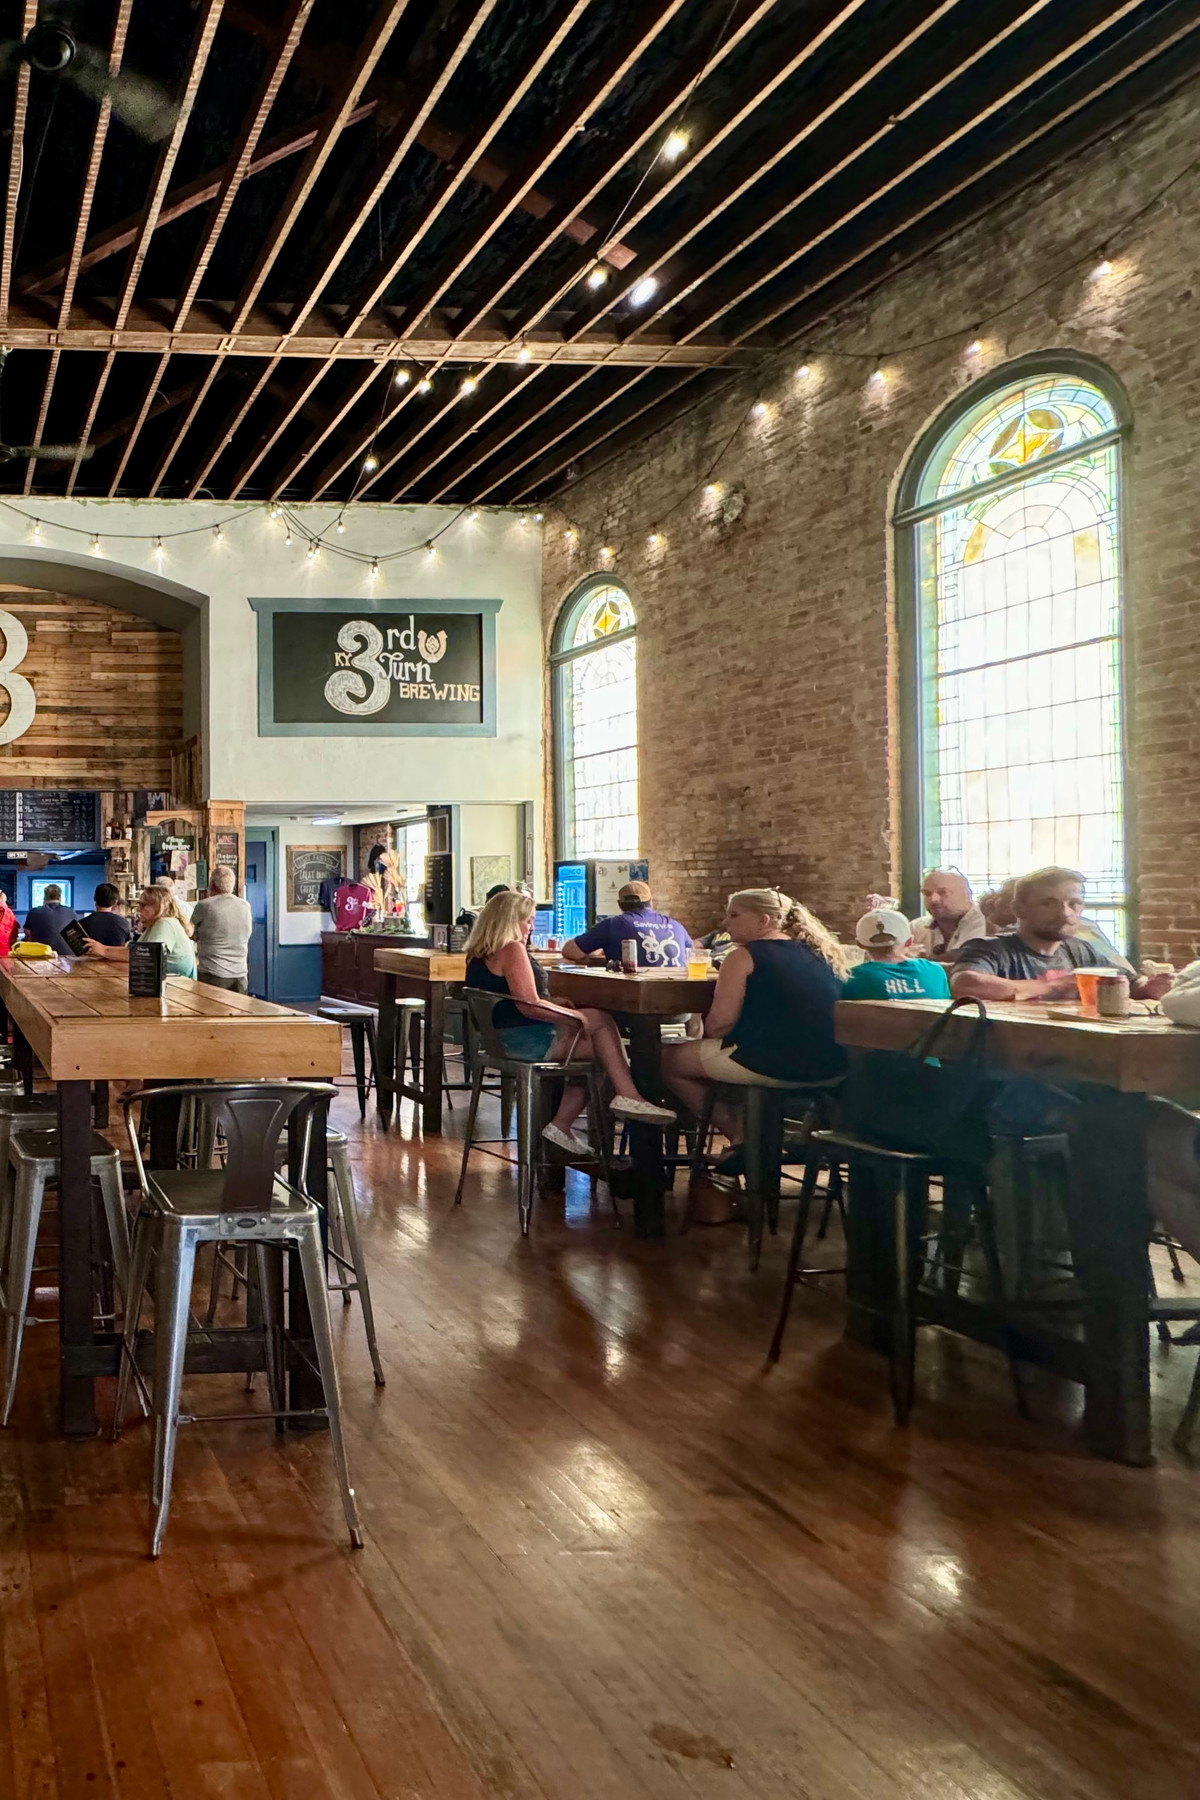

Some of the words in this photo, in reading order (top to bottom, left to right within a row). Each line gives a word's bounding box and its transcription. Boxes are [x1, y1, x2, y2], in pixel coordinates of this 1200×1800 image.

[334, 652, 353, 667] KY
[379, 652, 435, 683] Turn
[399, 682, 481, 702] BREWING
[633, 920, 659, 930] Saving
[884, 978, 926, 994] HILL
